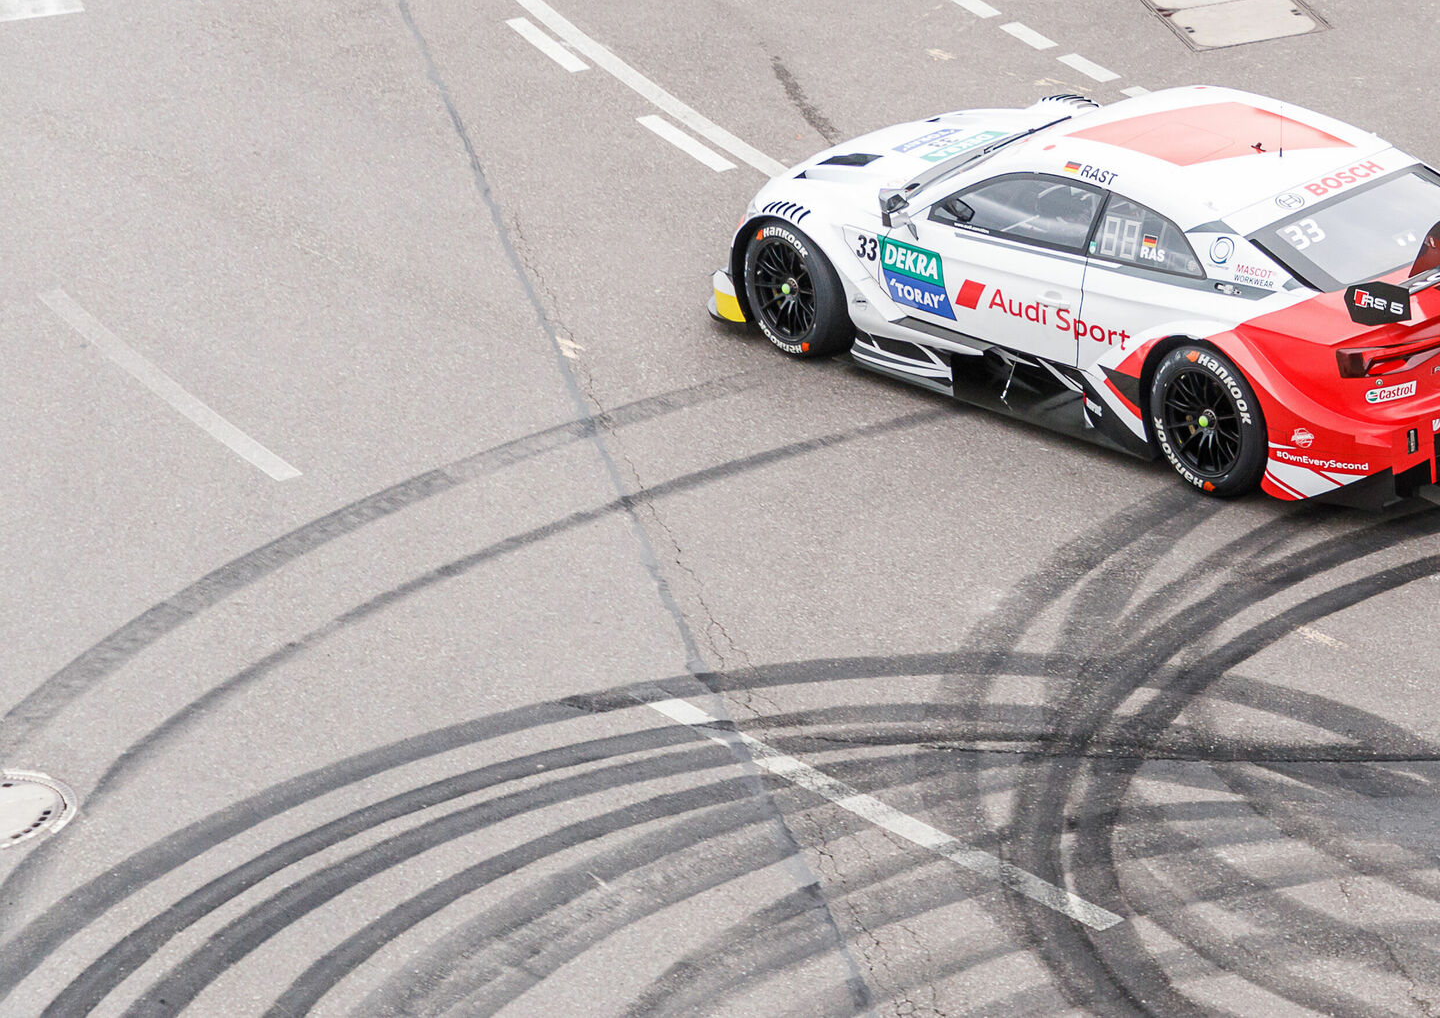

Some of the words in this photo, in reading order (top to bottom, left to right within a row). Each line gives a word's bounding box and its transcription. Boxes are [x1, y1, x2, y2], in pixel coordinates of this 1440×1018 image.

[1080, 164, 1119, 186] RAST
[1304, 160, 1385, 197] BOSCH
[1284, 218, 1326, 250] 33
[856, 234, 878, 262] 33
[1140, 246, 1166, 262] RAS
[884, 243, 939, 280] DEKRA
[1235, 263, 1273, 279] MASCOT
[1233, 274, 1275, 289] WORKWEAR
[1360, 293, 1387, 311] RS
[1390, 301, 1404, 315] 5
[988, 288, 1049, 325] Audi
[1056, 308, 1131, 350] Sport
[1379, 383, 1413, 400] Castrol
[1276, 450, 1369, 471] #OwnEverySecond
